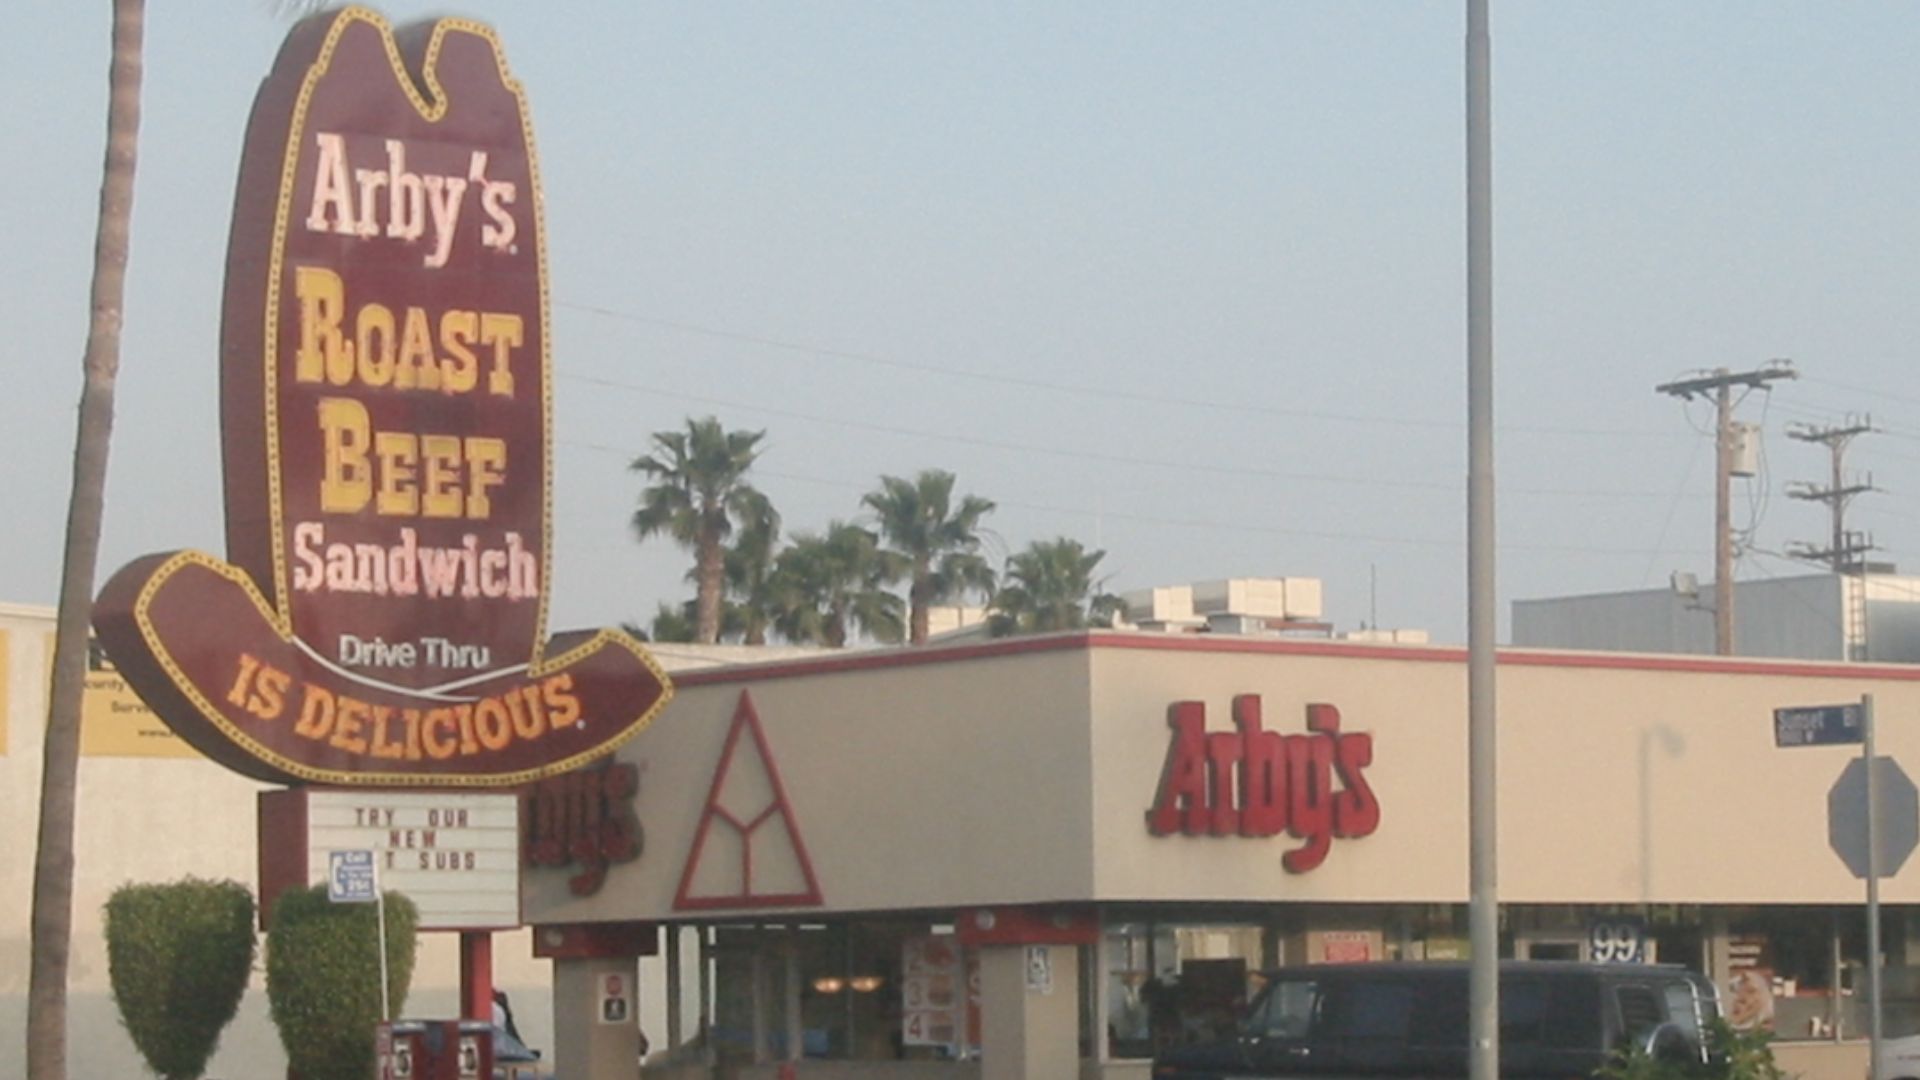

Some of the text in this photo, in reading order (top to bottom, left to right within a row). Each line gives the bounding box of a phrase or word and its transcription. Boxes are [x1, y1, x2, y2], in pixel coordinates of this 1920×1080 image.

[306, 132, 517, 268] Arby's
[296, 266, 523, 396] ROAST
[318, 397, 507, 519] BEEF
[293, 521, 538, 601] Sandwich
[339, 634, 491, 669] Drive Thru
[227, 653, 580, 761] IS DELICIOUS
[355, 808, 469, 827] TRY OUR
[1145, 694, 1380, 874] Arby's
[389, 831, 438, 848] NEW
[419, 852, 476, 870] SUBS
